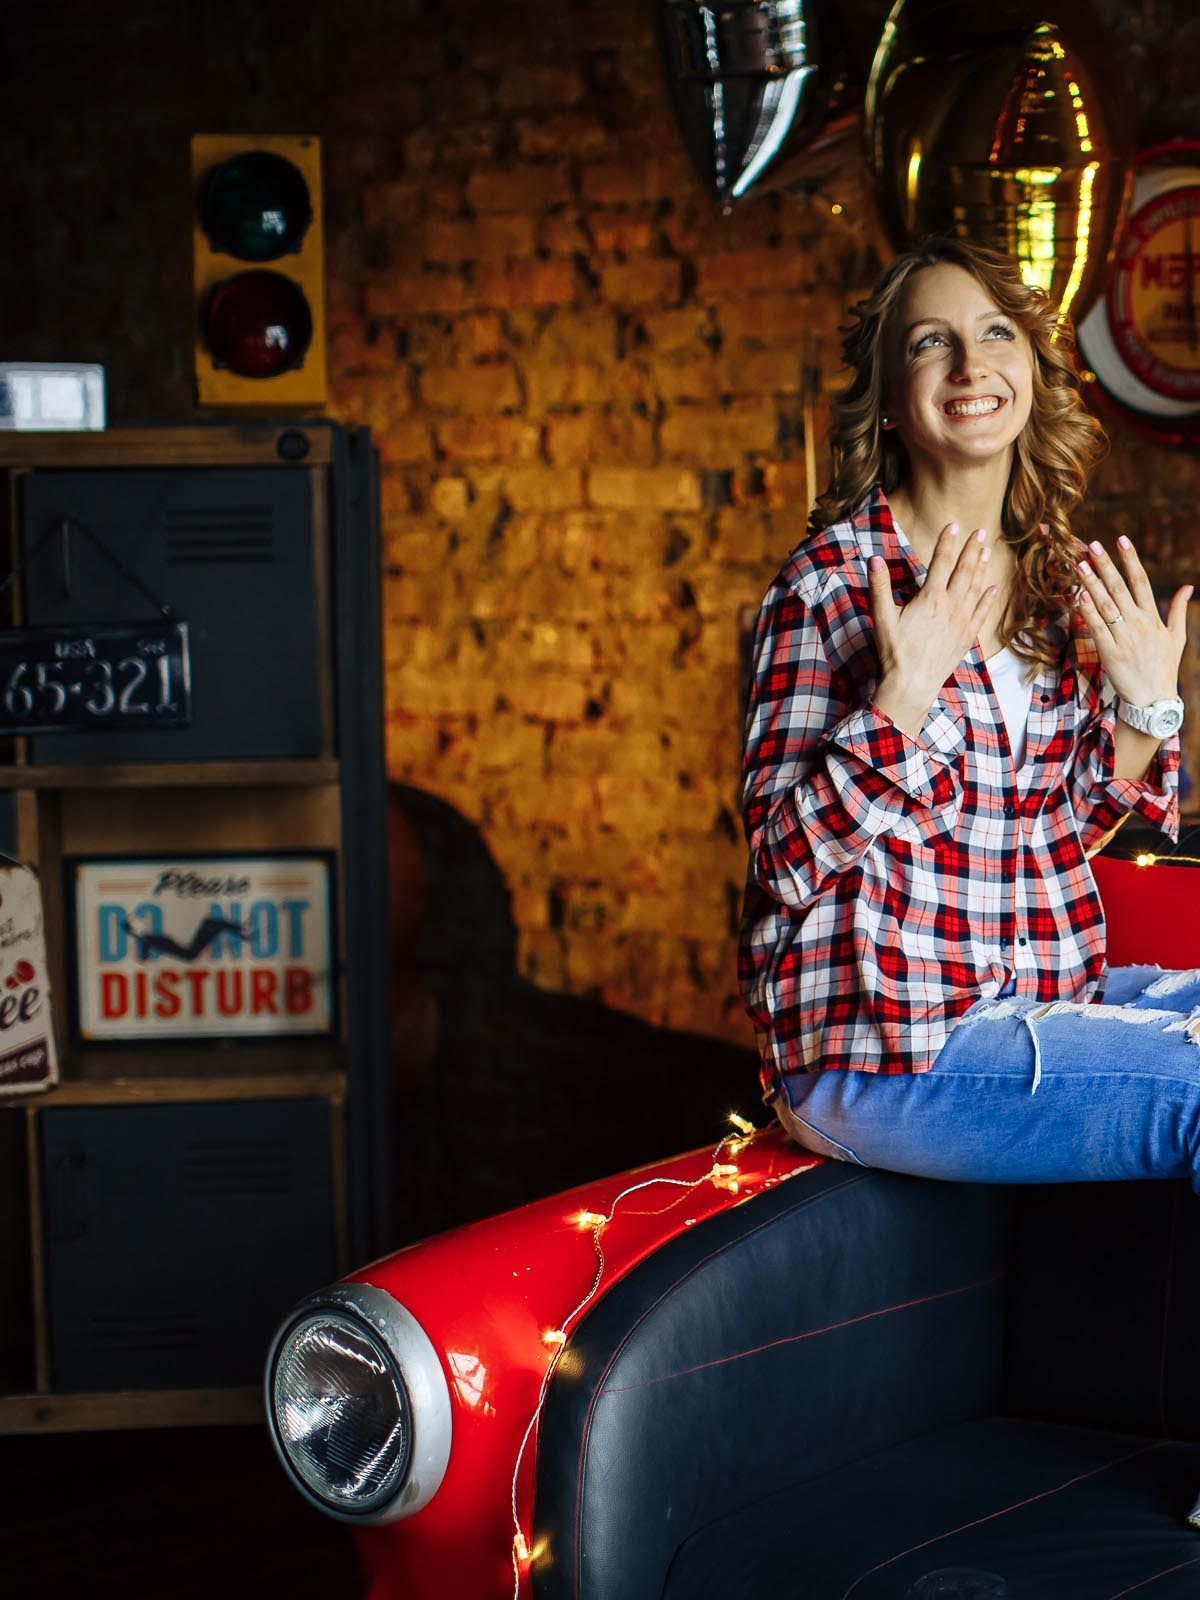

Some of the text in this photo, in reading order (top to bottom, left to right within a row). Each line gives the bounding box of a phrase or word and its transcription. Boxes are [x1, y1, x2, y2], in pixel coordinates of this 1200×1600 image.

[153, 868, 250, 897] Please
[98, 899, 310, 963] DO NOT
[100, 967, 313, 1019] DISTURB
